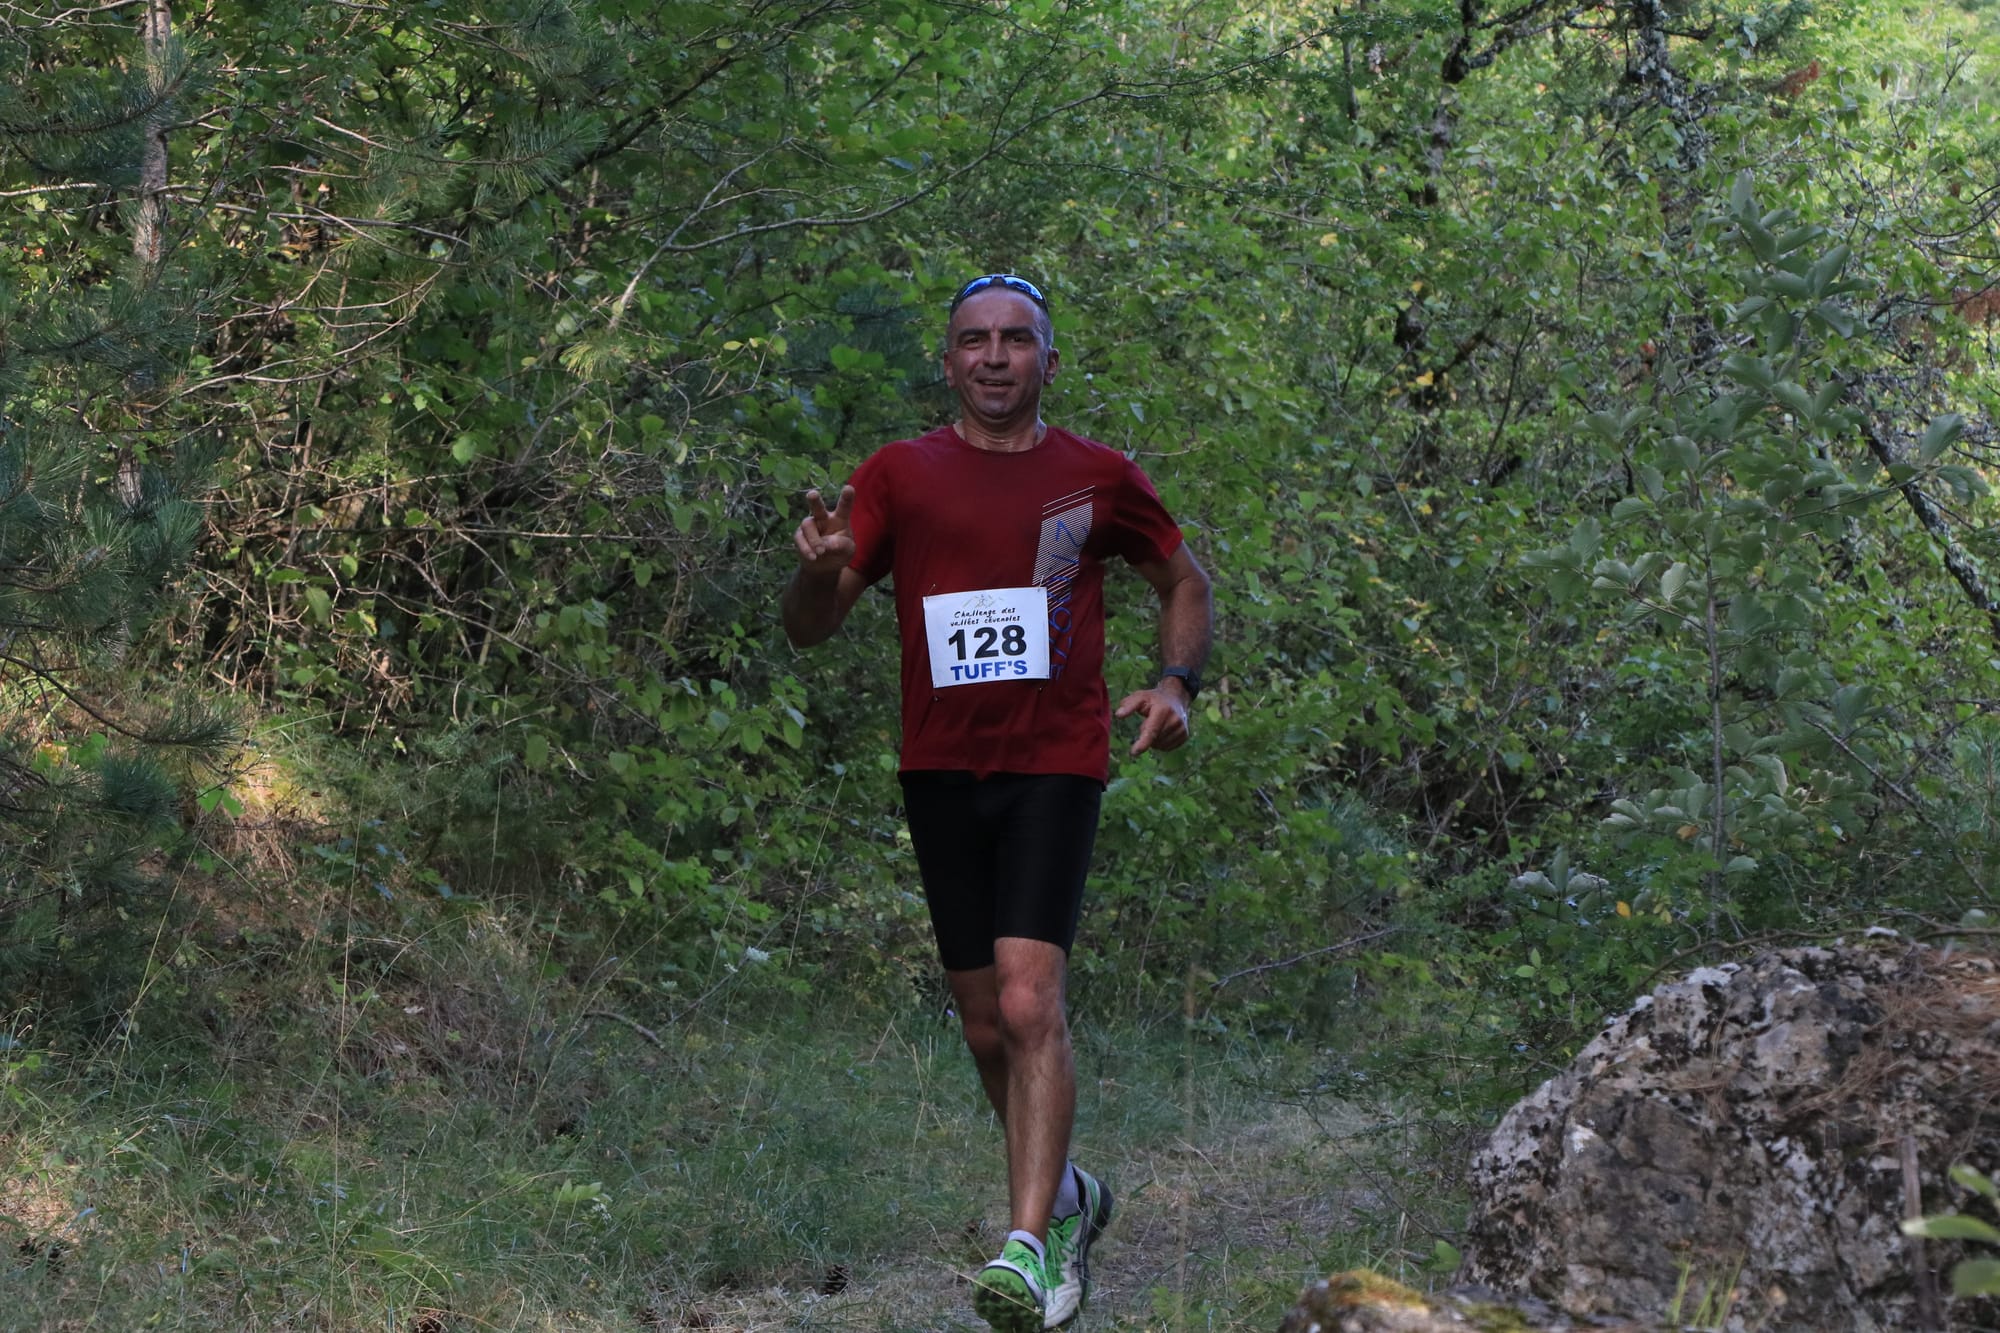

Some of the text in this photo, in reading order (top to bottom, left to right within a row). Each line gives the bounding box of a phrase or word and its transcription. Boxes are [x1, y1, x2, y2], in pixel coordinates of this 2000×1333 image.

[954, 609, 996, 618] Challenge
[950, 617, 980, 627] vallées
[948, 624, 1027, 661] 128
[950, 660, 1028, 681] TUFF'S
